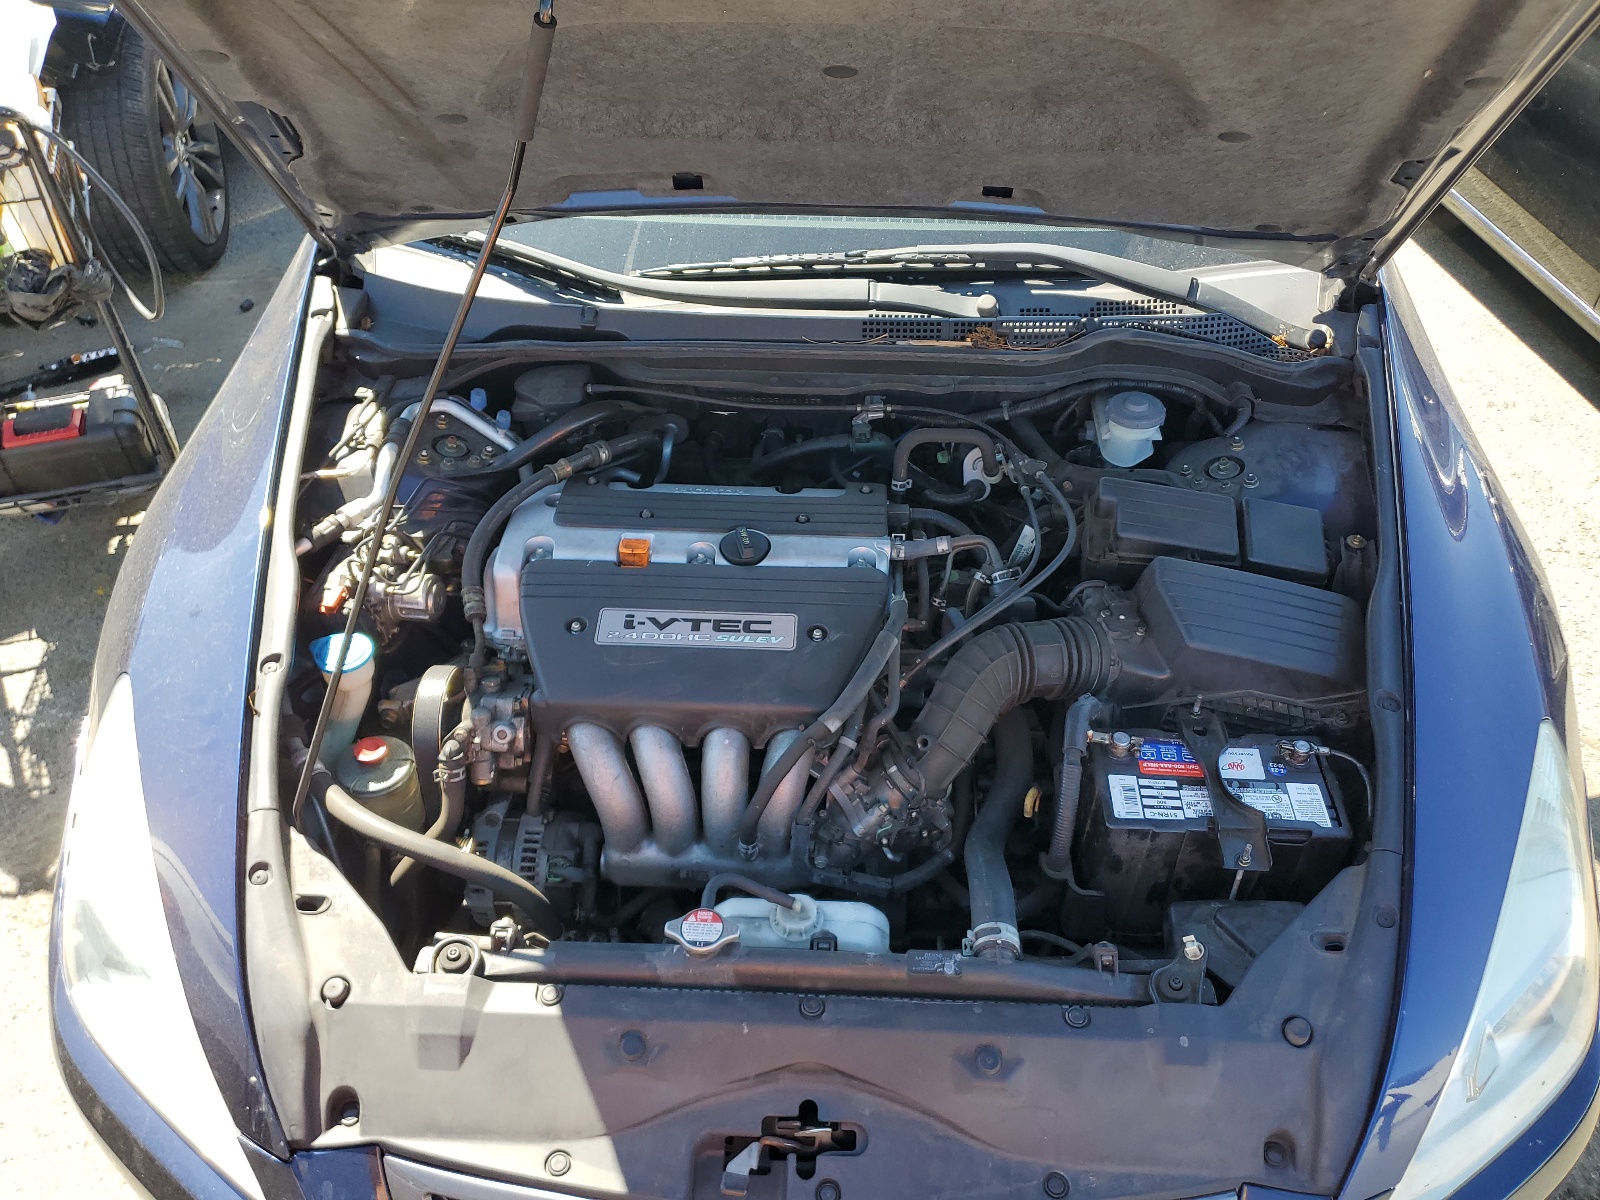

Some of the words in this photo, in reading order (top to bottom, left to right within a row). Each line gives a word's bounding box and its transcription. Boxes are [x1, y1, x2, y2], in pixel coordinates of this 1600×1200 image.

[623, 614, 772, 634] i-VTEC
[606, 630, 638, 640] 2.4
[641, 631, 712, 642] DOHC
[714, 634, 786, 645] SULEV
